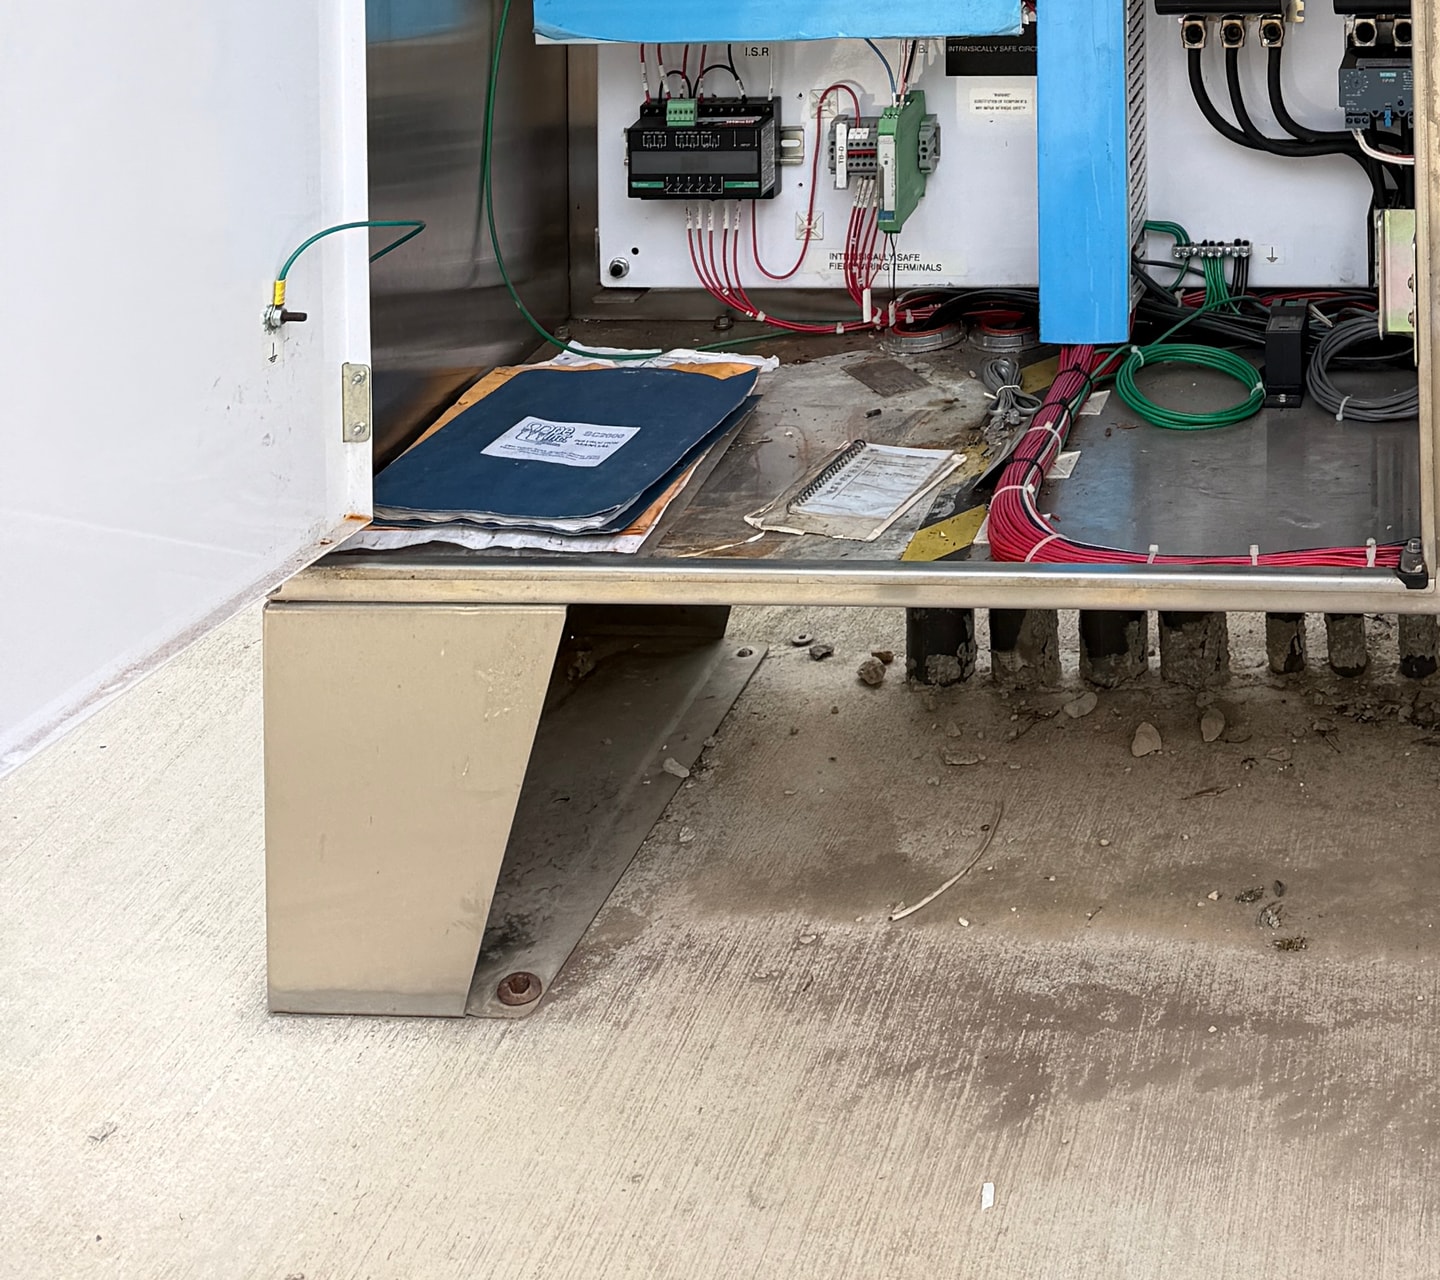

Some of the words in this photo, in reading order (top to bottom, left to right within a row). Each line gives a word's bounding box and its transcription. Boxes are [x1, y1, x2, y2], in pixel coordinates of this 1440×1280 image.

[948, 45, 998, 53] INTRINSICALLY
[896, 253, 920, 262] SAFE
[892, 263, 942, 272] TERMINALS
